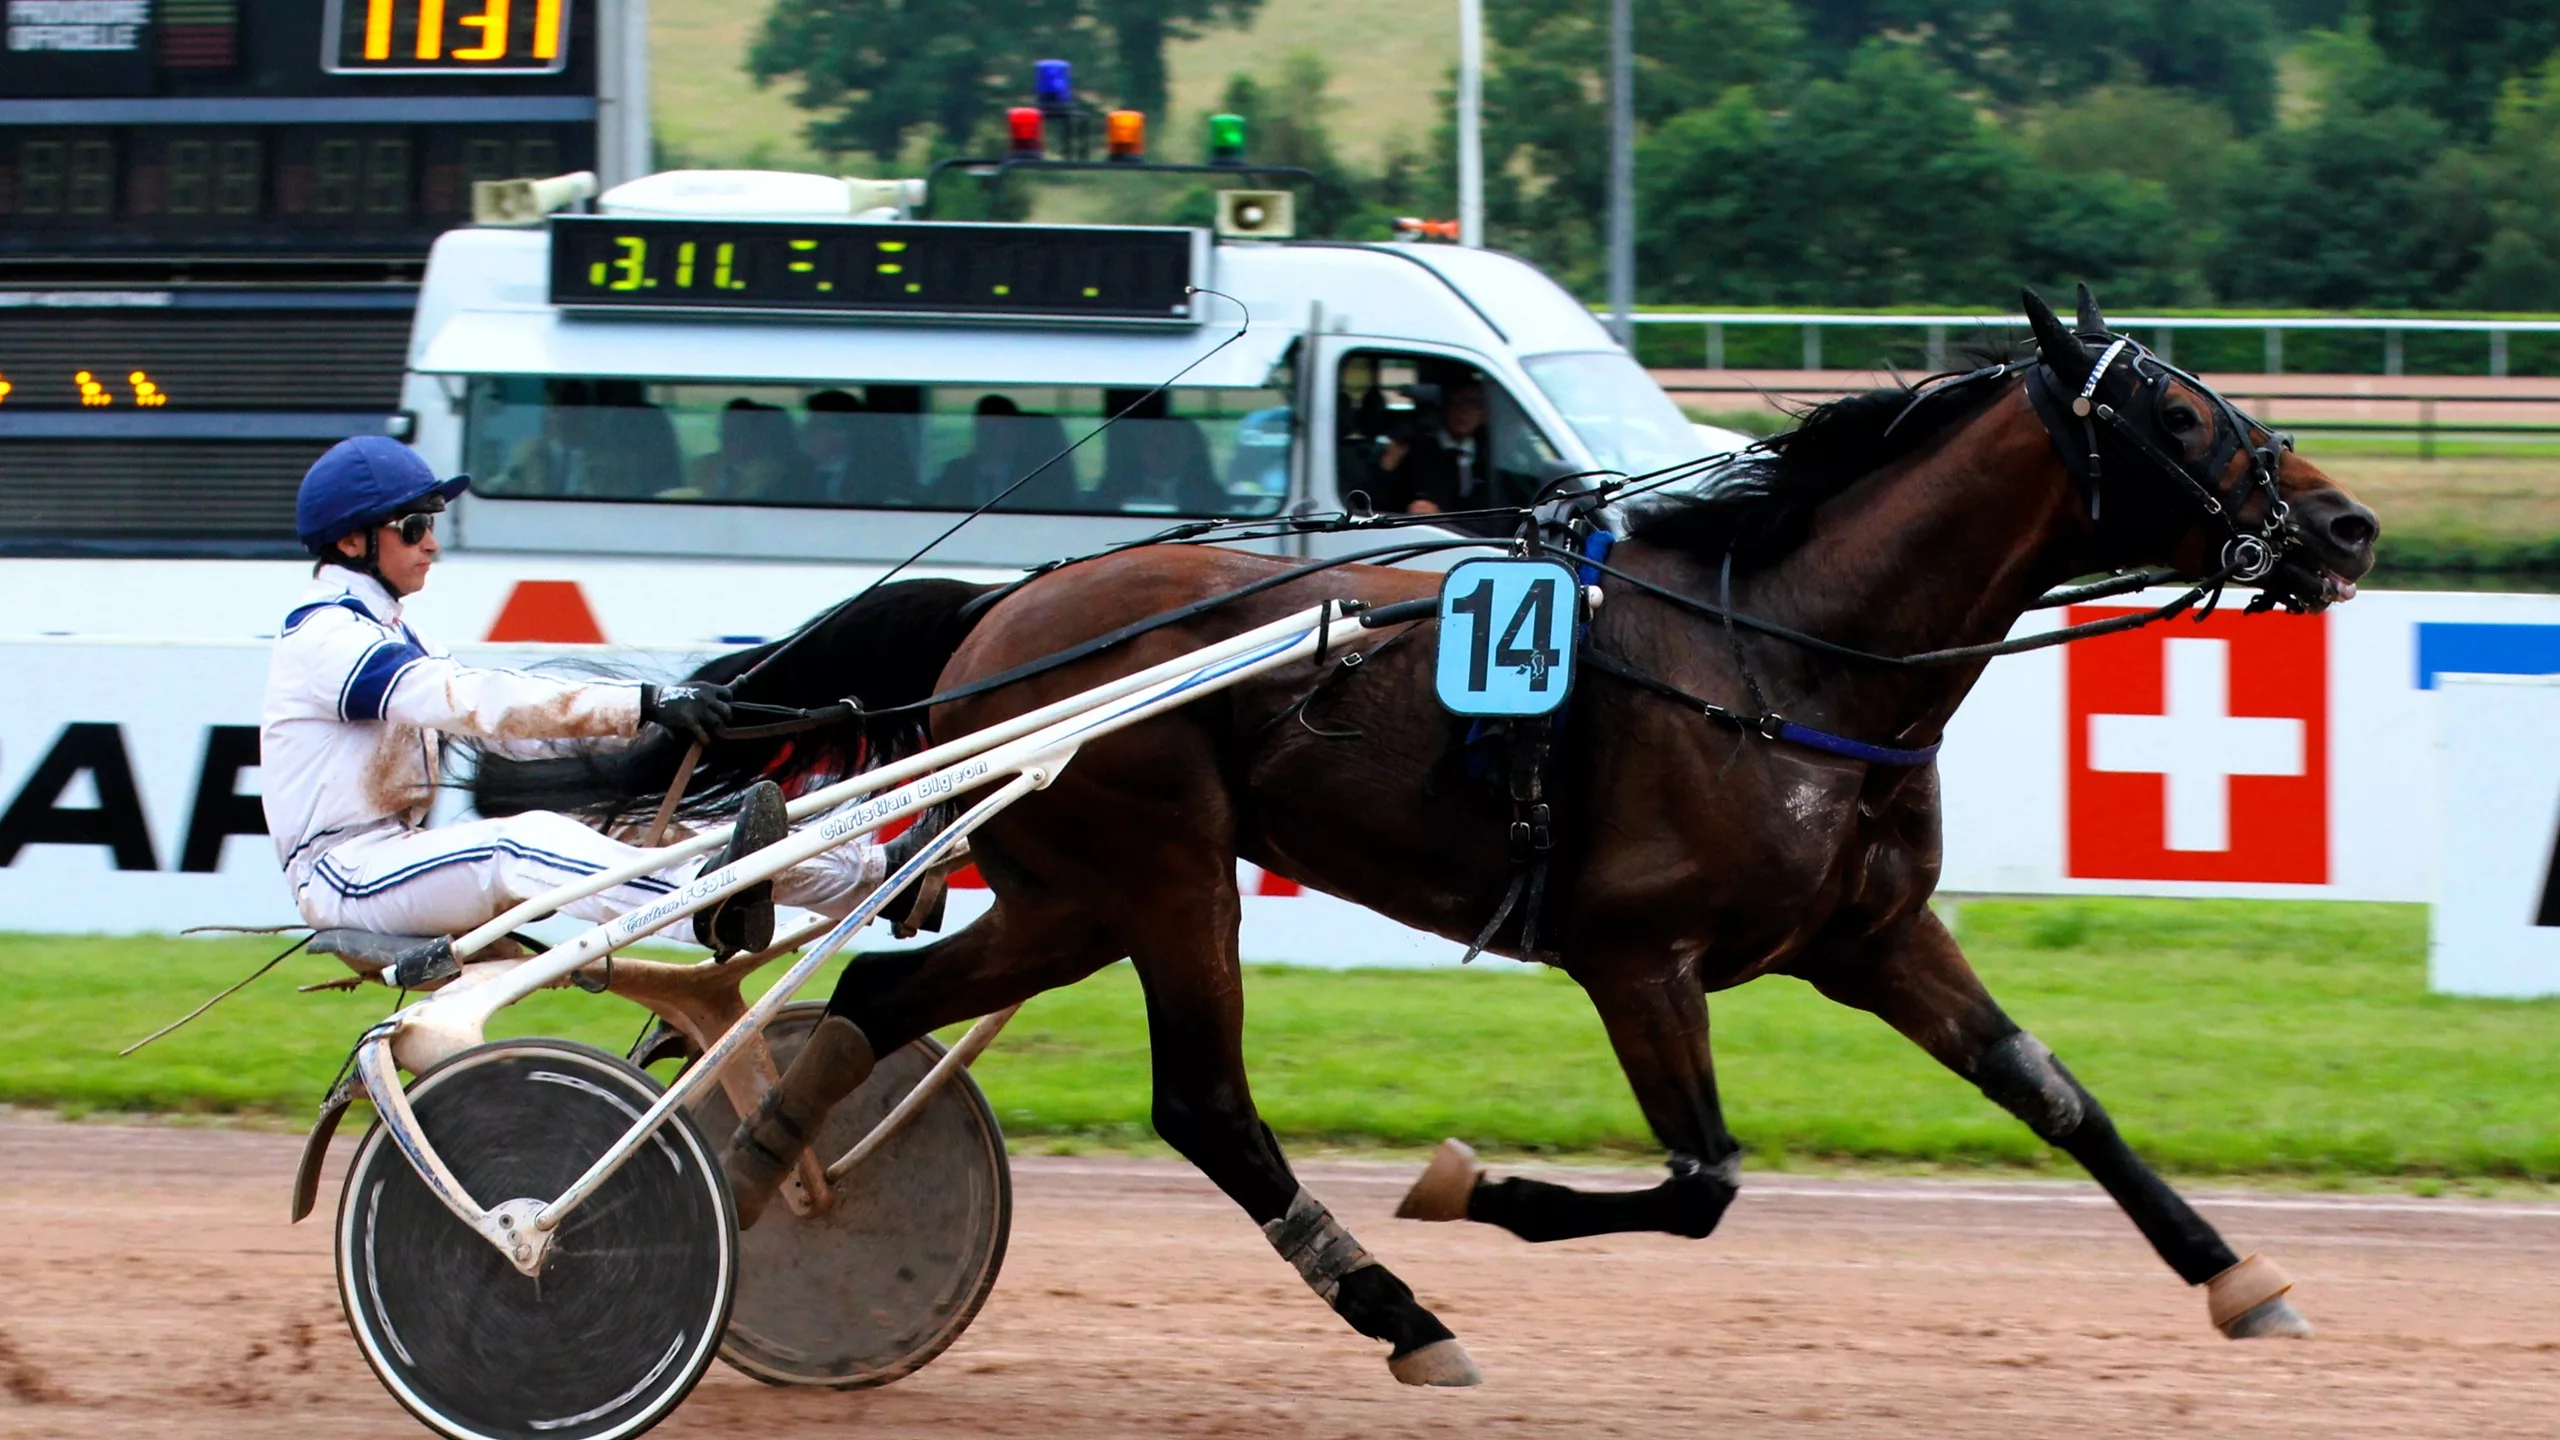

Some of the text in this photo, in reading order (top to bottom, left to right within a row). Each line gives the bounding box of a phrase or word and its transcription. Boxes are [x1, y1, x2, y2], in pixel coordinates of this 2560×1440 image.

[1452, 578, 1560, 692] 14
[820, 760, 988, 840] Christian Bigeon
